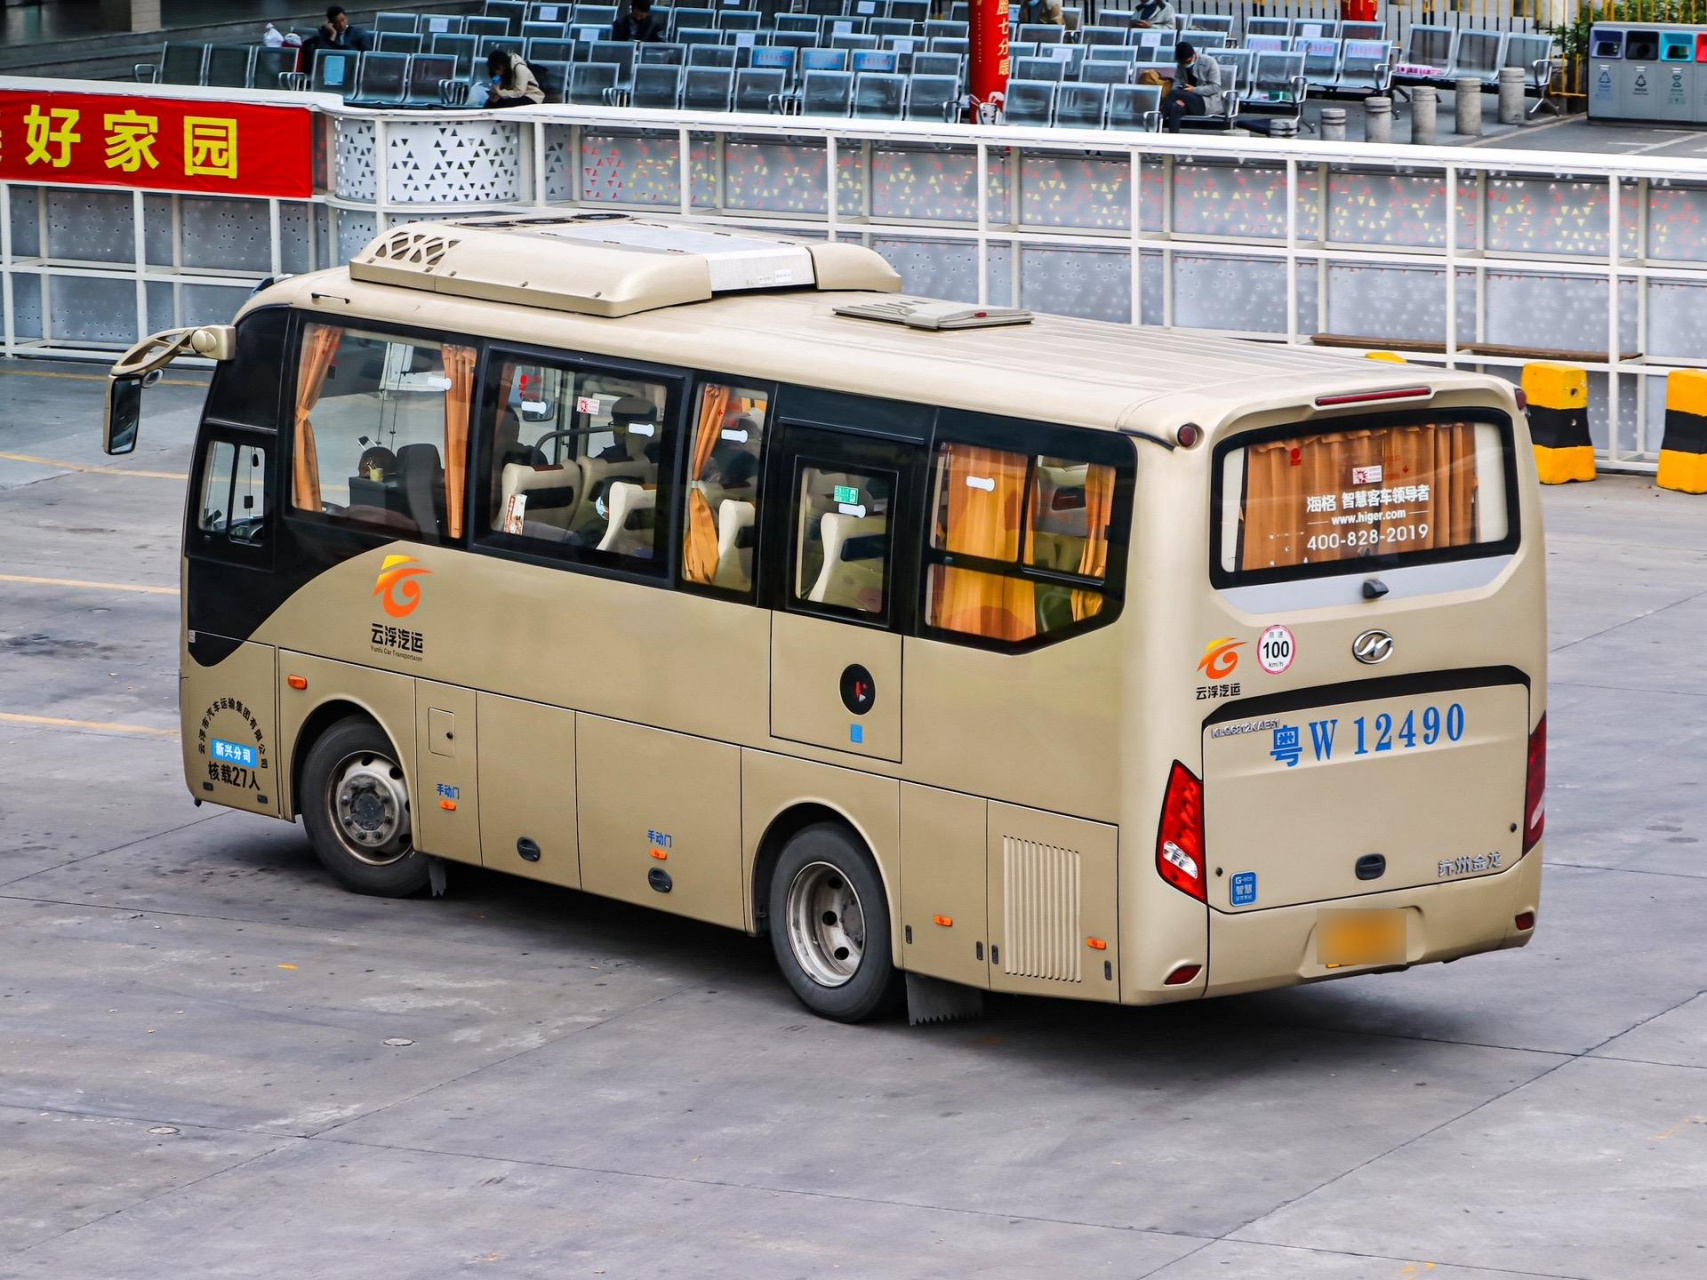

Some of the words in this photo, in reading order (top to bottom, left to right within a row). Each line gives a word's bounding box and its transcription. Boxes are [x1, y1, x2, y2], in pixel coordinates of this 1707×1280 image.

[0, 104, 238, 179] 好家园
[1306, 494, 1337, 513] 海格
[1342, 484, 1430, 509] 智慧客车领导者
[1331, 509, 1406, 526] www.higer.com
[1307, 523, 1429, 551] 400-828-2019
[371, 622, 424, 654] 云浮汽运
[383, 647, 392, 655] Car
[1263, 640, 1290, 659] 100
[1196, 682, 1241, 700] 云浮汽运
[215, 741, 251, 763] 新兴分司
[207, 760, 261, 791] 核载27人
[436, 783, 460, 800] 手动门
[647, 829, 672, 848] 手动门
